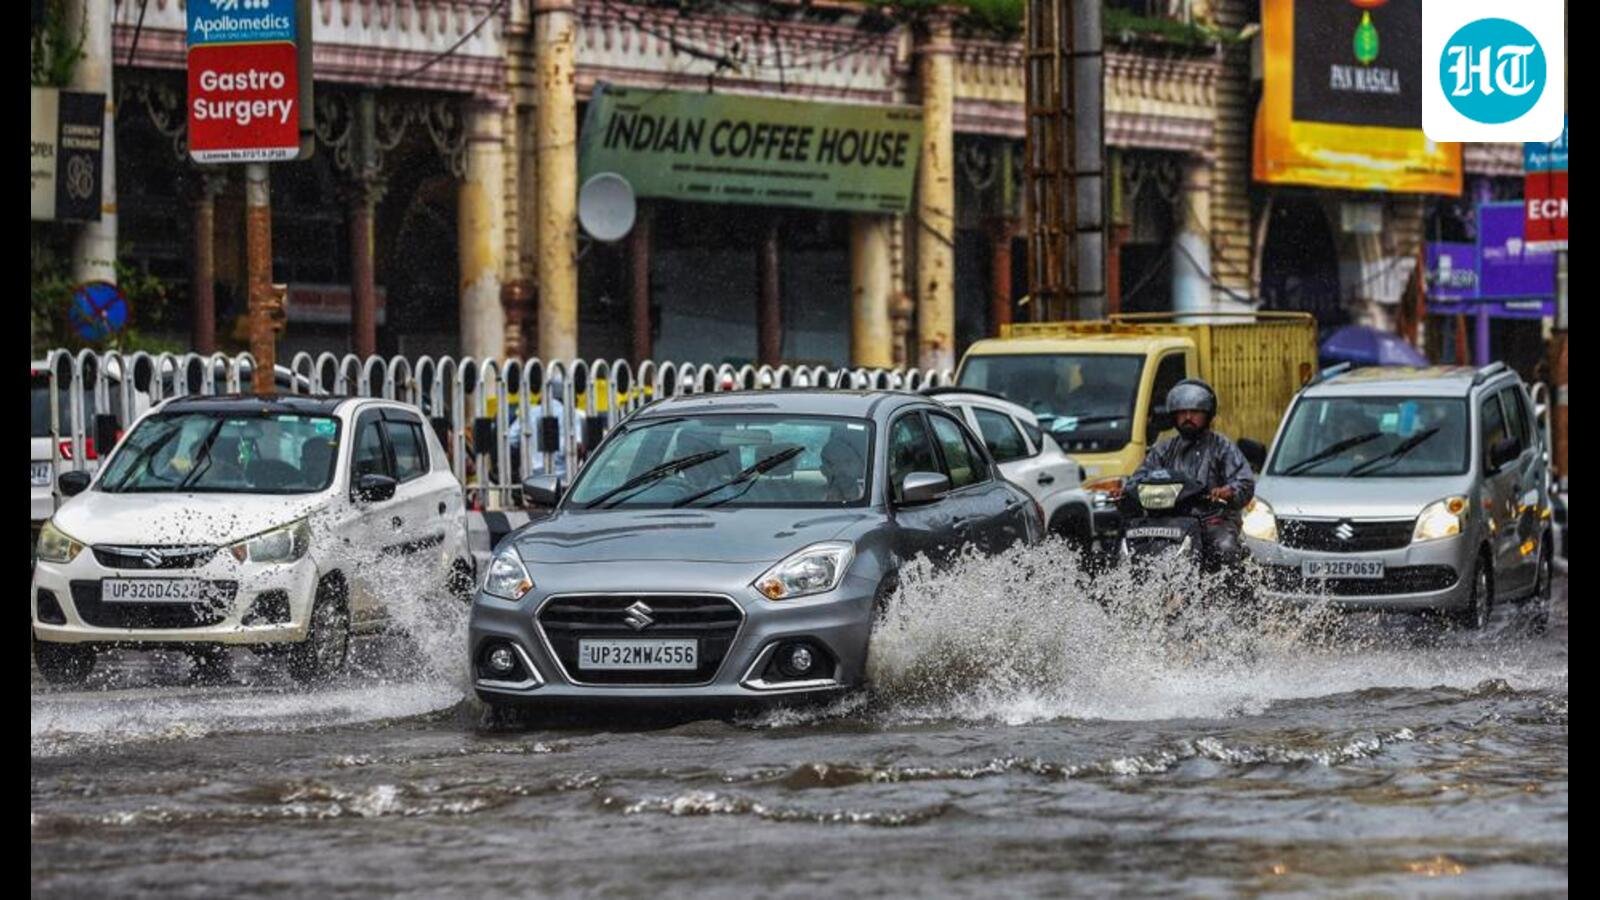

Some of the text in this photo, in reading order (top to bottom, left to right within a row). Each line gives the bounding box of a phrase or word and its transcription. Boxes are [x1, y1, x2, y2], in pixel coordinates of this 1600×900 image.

[193, 13, 290, 40] Apollomedics
[200, 70, 285, 92] Gastro
[1330, 64, 1400, 95] PAN MASALA
[193, 98, 293, 126] Surgery
[603, 112, 910, 168] INDIAN COFFEE HOUSE
[590, 646, 694, 664] UP32MW4556
